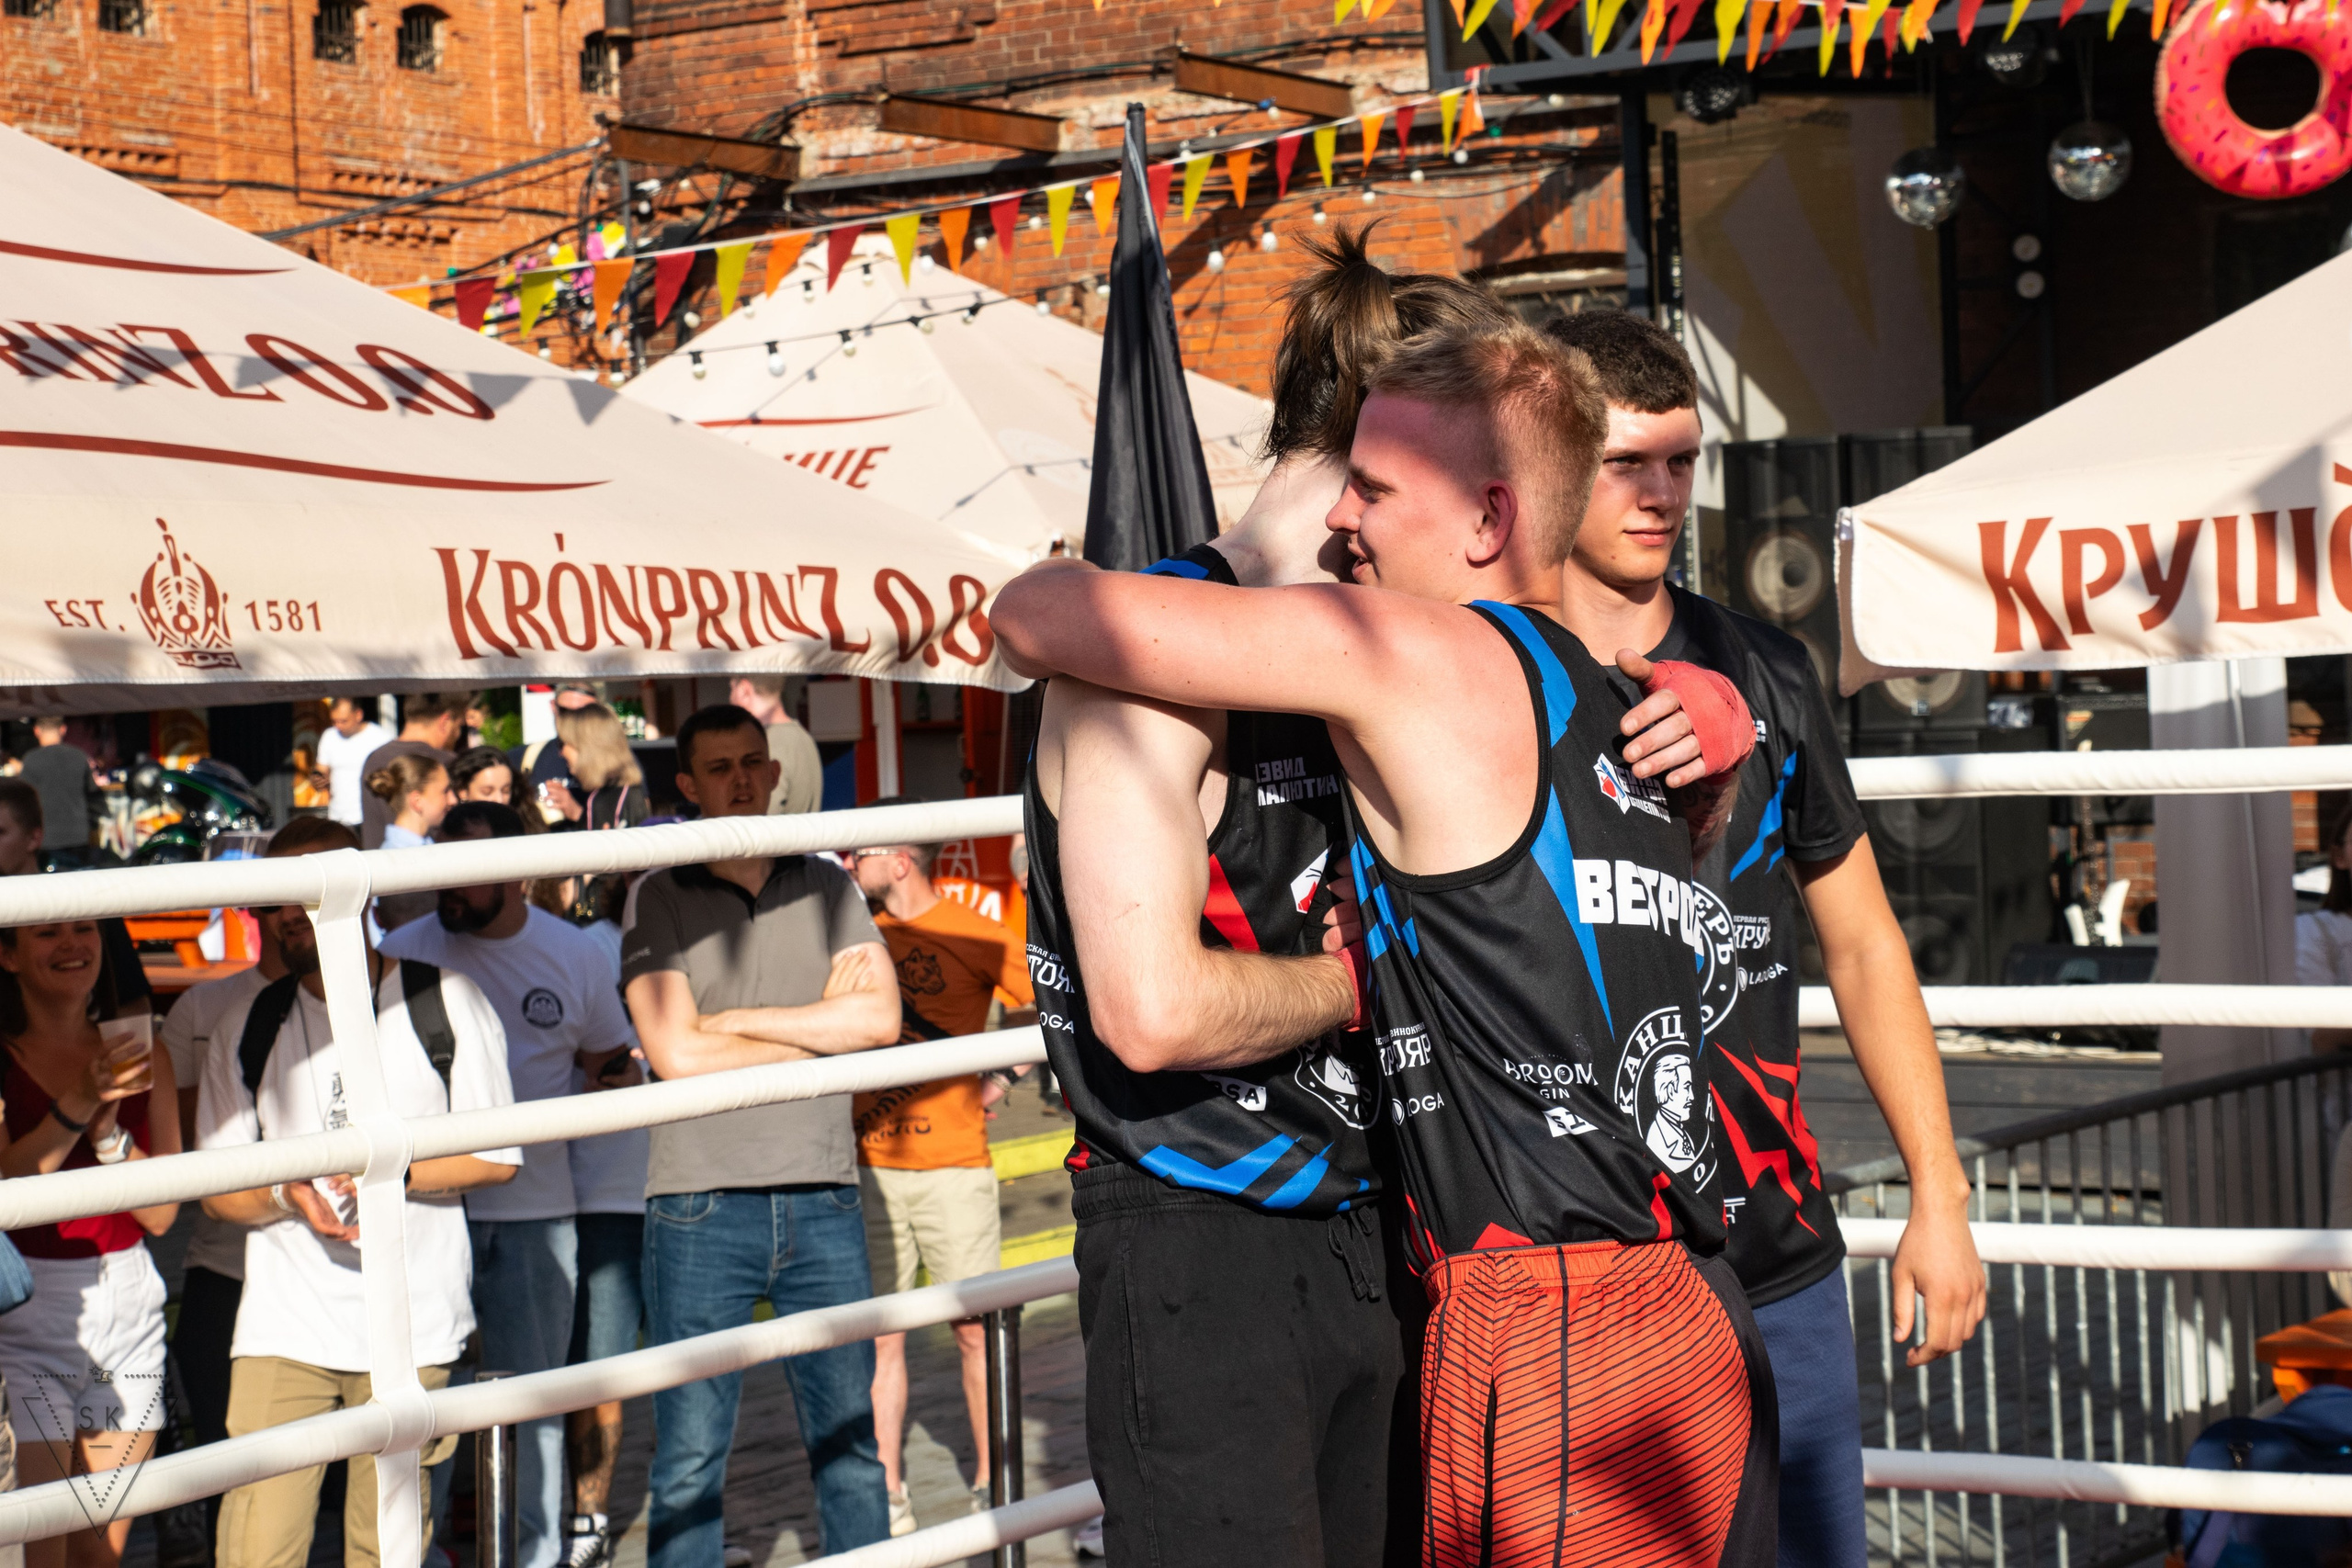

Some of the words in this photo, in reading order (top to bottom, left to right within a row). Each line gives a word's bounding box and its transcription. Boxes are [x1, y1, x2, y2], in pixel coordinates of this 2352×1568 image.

[44, 600, 126, 632] EST.
[243, 599, 322, 632] 1581
[1539, 1087, 1571, 1100] GIN
